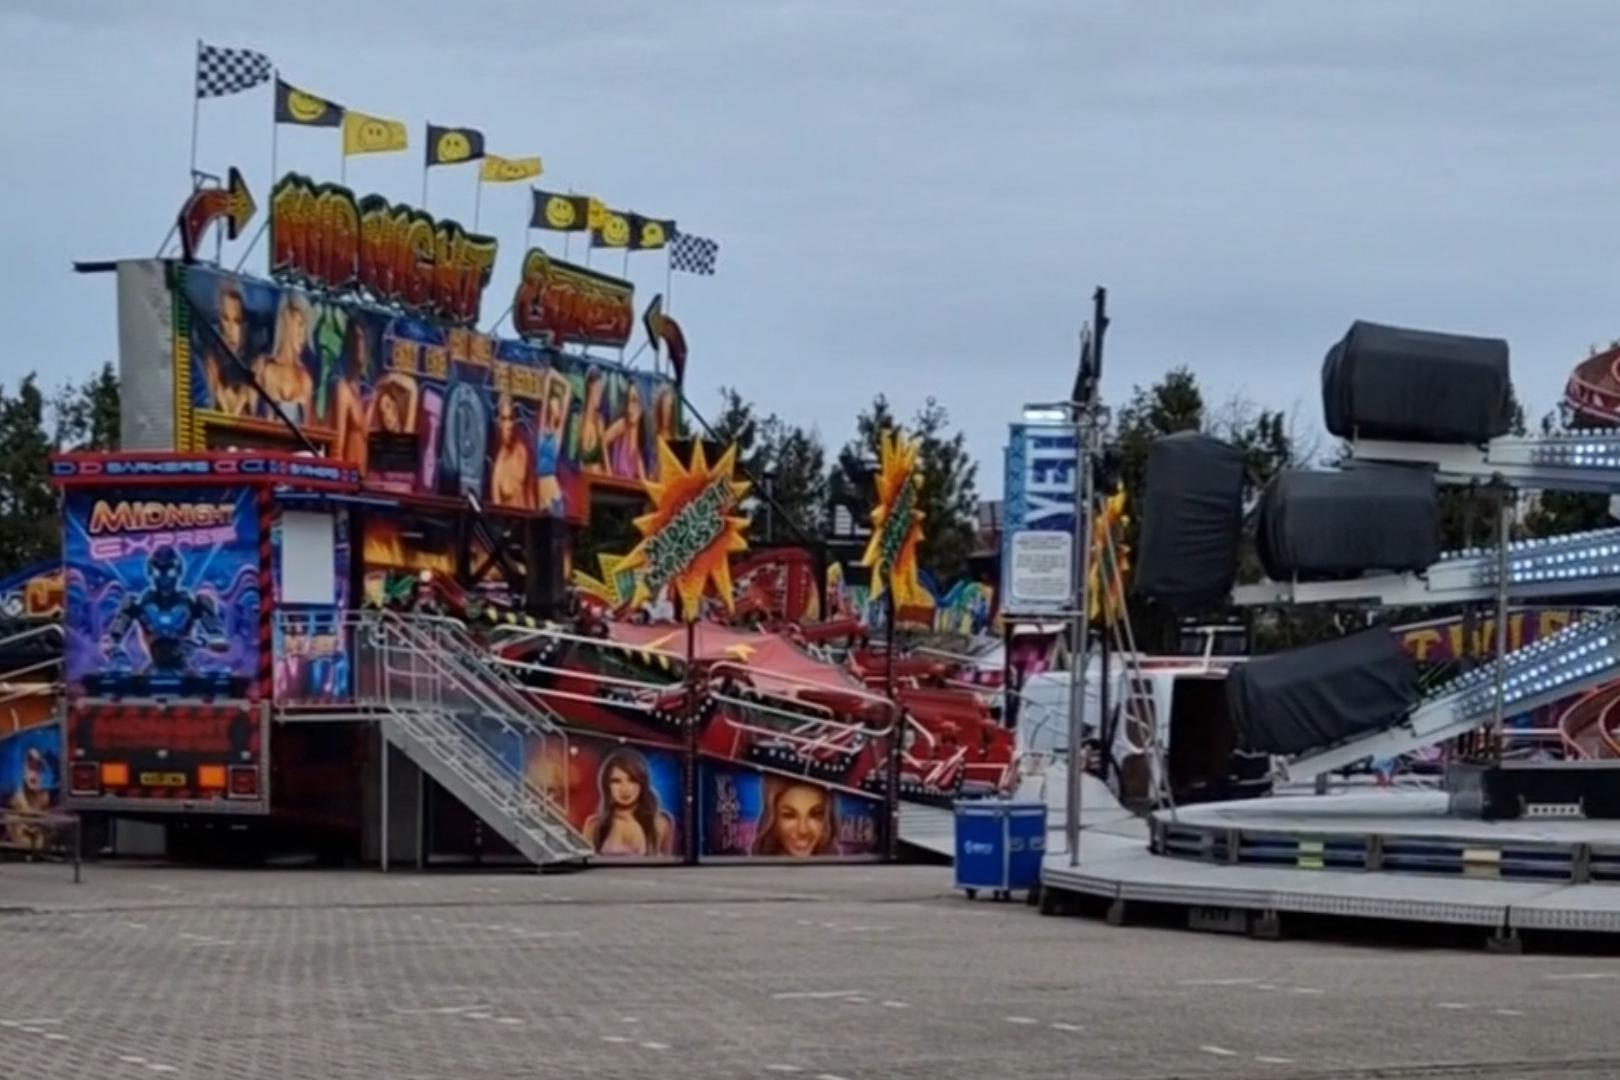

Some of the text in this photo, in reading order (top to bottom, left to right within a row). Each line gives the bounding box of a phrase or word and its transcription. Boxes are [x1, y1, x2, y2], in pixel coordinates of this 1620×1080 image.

[106, 461, 210, 474] BARKERS
[1024, 428, 1076, 525] YETI
[90, 500, 236, 533] MIDNIGHT
